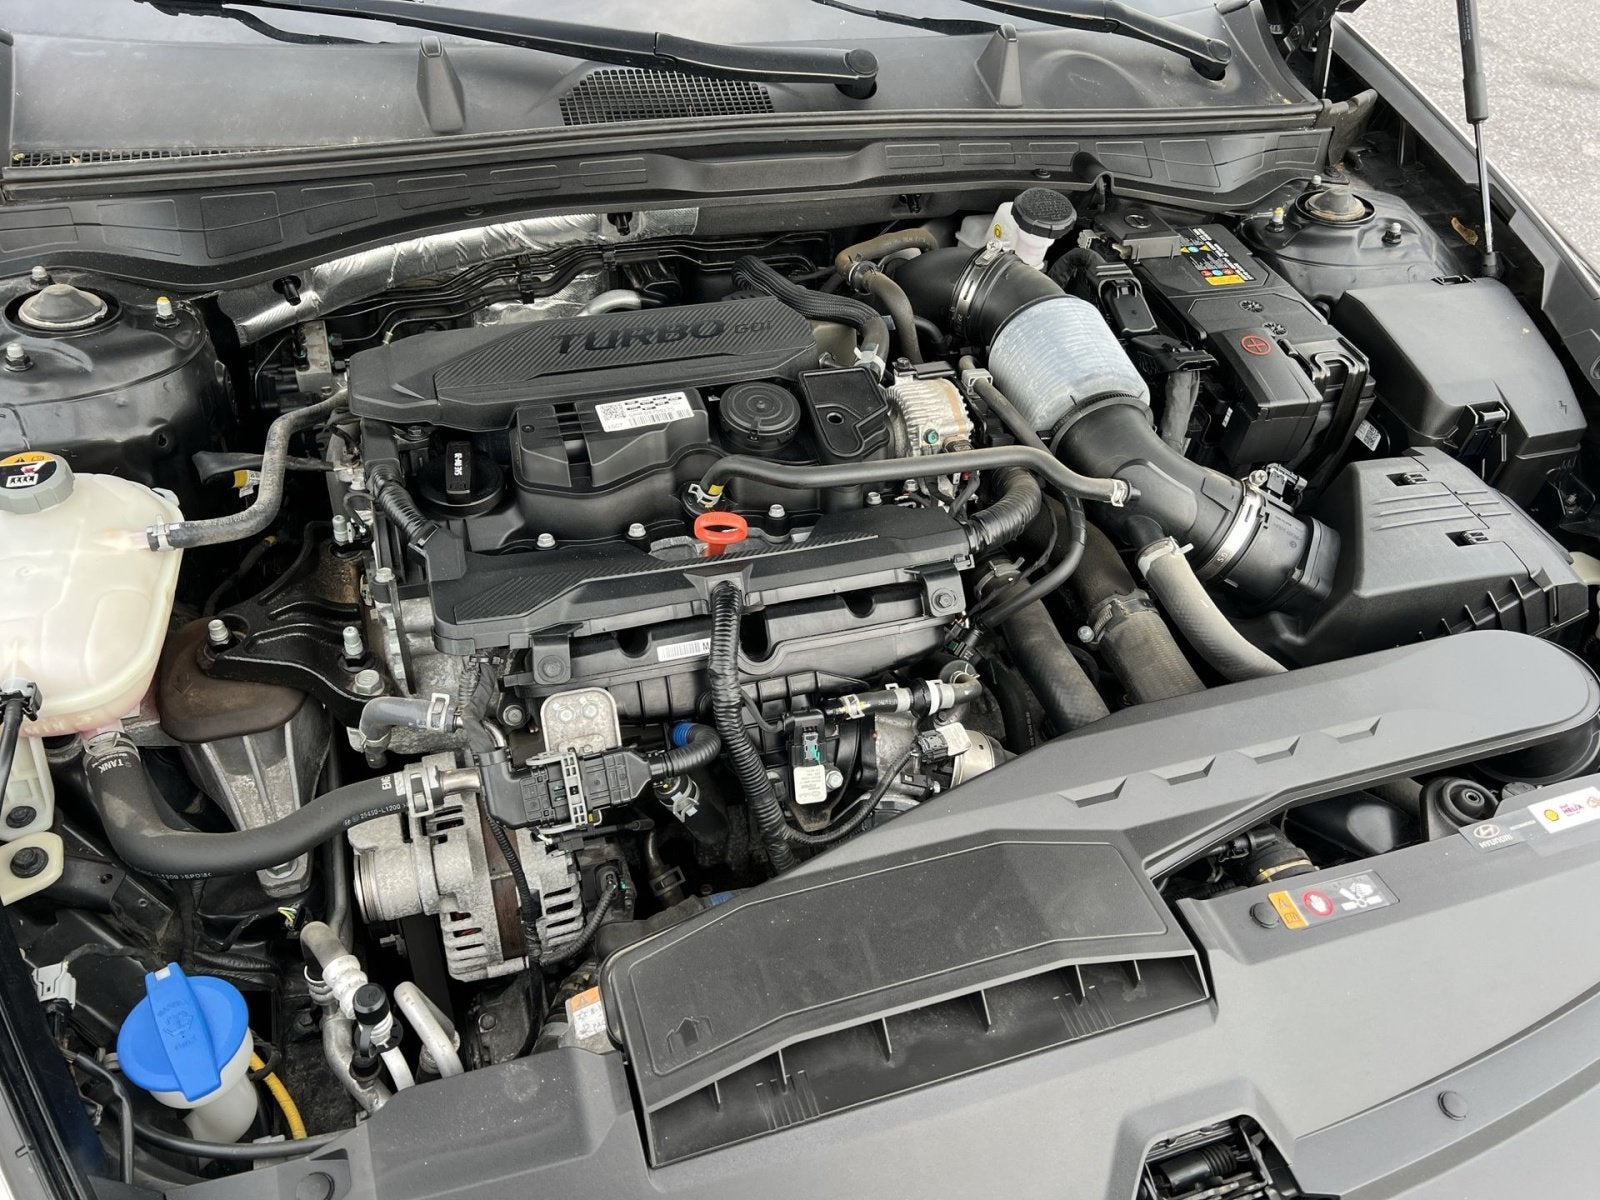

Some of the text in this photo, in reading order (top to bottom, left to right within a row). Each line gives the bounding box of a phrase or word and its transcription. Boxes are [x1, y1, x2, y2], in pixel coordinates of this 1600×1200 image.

[552, 318, 724, 353] TURBO
[98, 758, 124, 774] TANK
[1479, 833, 1513, 848] HYUNDAI
